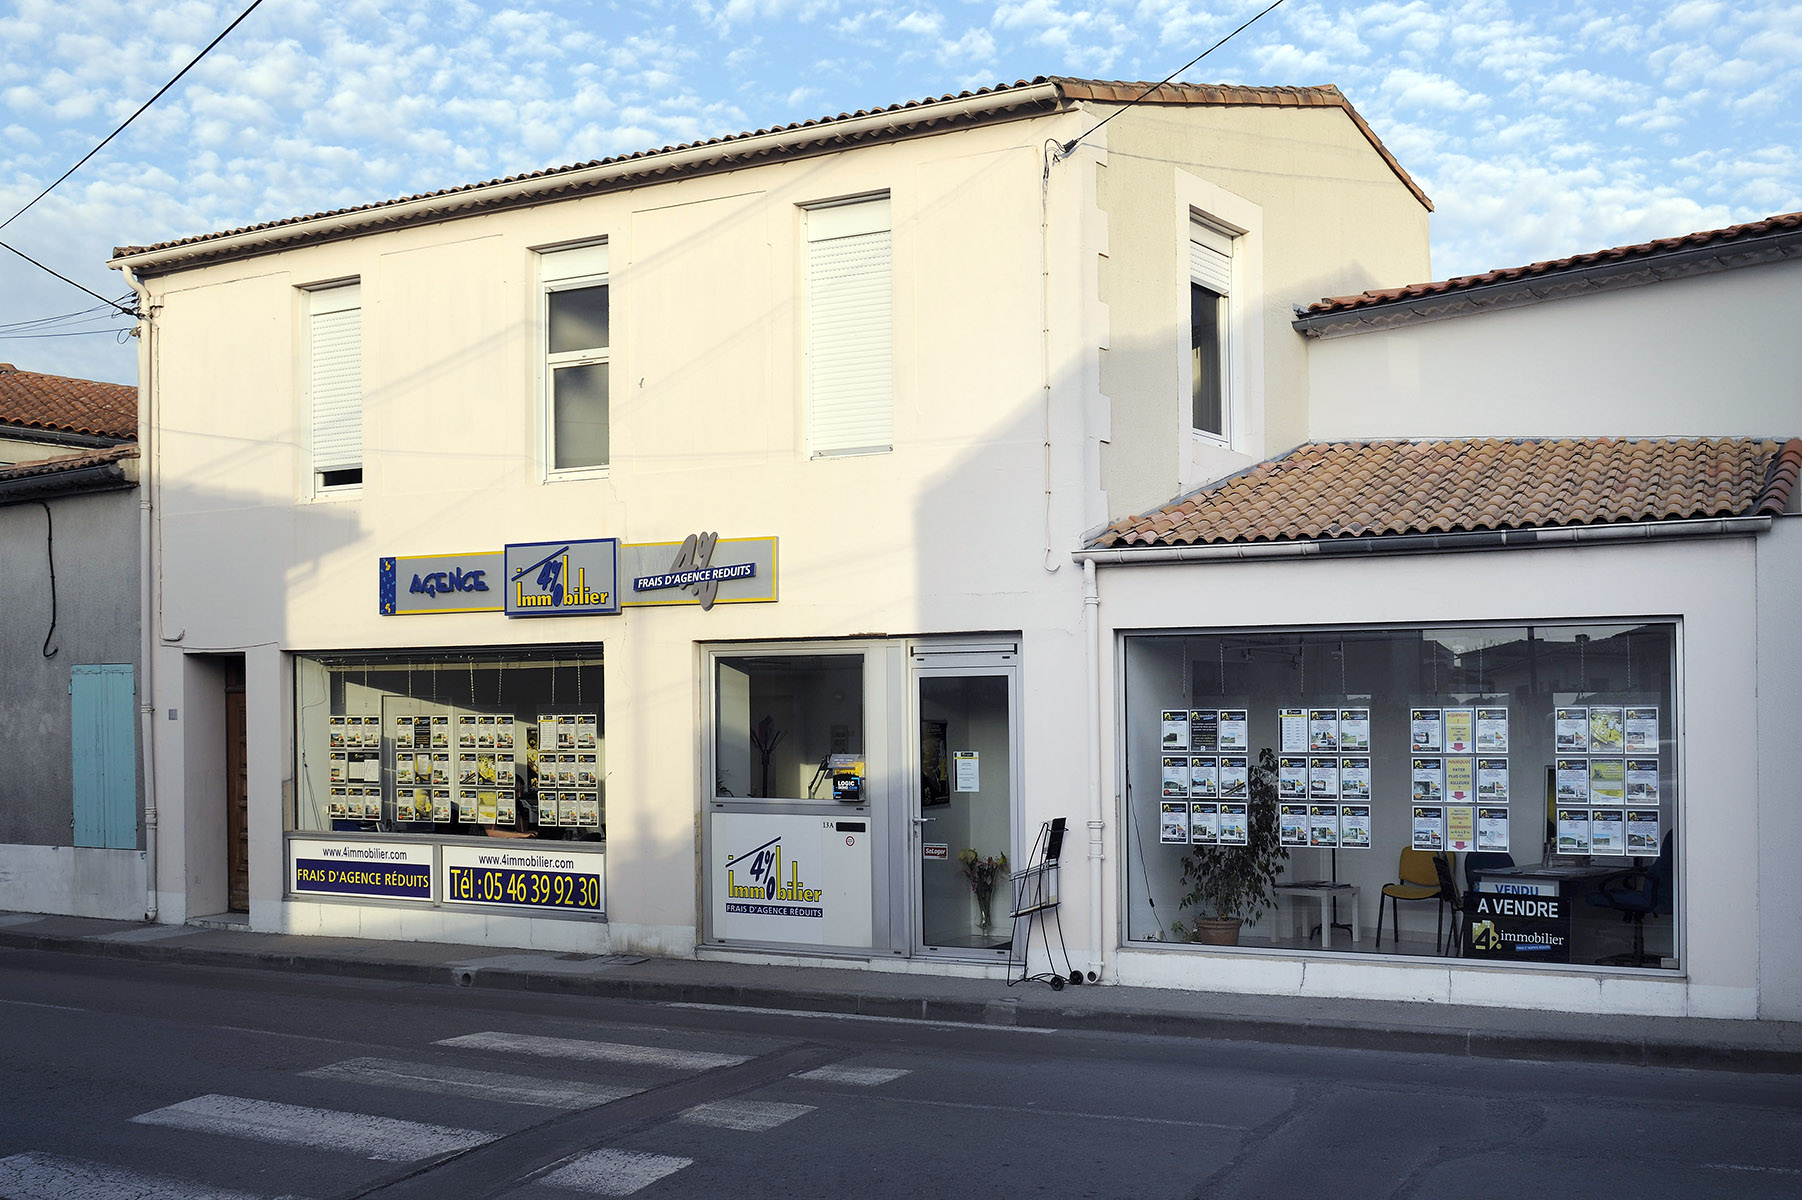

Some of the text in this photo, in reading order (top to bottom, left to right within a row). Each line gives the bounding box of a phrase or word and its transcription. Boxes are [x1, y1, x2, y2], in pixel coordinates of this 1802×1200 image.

[409, 567, 490, 598] AGENCE
[638, 565, 751, 588] FRAIS D'AGENCE REDUITS
[322, 847, 407, 860] www.4immobilier.com
[478, 854, 574, 869] www.4immobilier.com
[297, 868, 429, 888] FRAIS D'AGENCE RÉDUITS
[506, 873, 527, 902] 46
[530, 874, 551, 904] 39
[554, 875, 574, 905] 92
[578, 877, 599, 907] 30
[1495, 884, 1540, 895] VENDU
[726, 904, 822, 917] FRAIS D'AGENCE RÉDUITS
[1477, 898, 1559, 918] A VENDRE
[1500, 930, 1565, 945] immobilier
